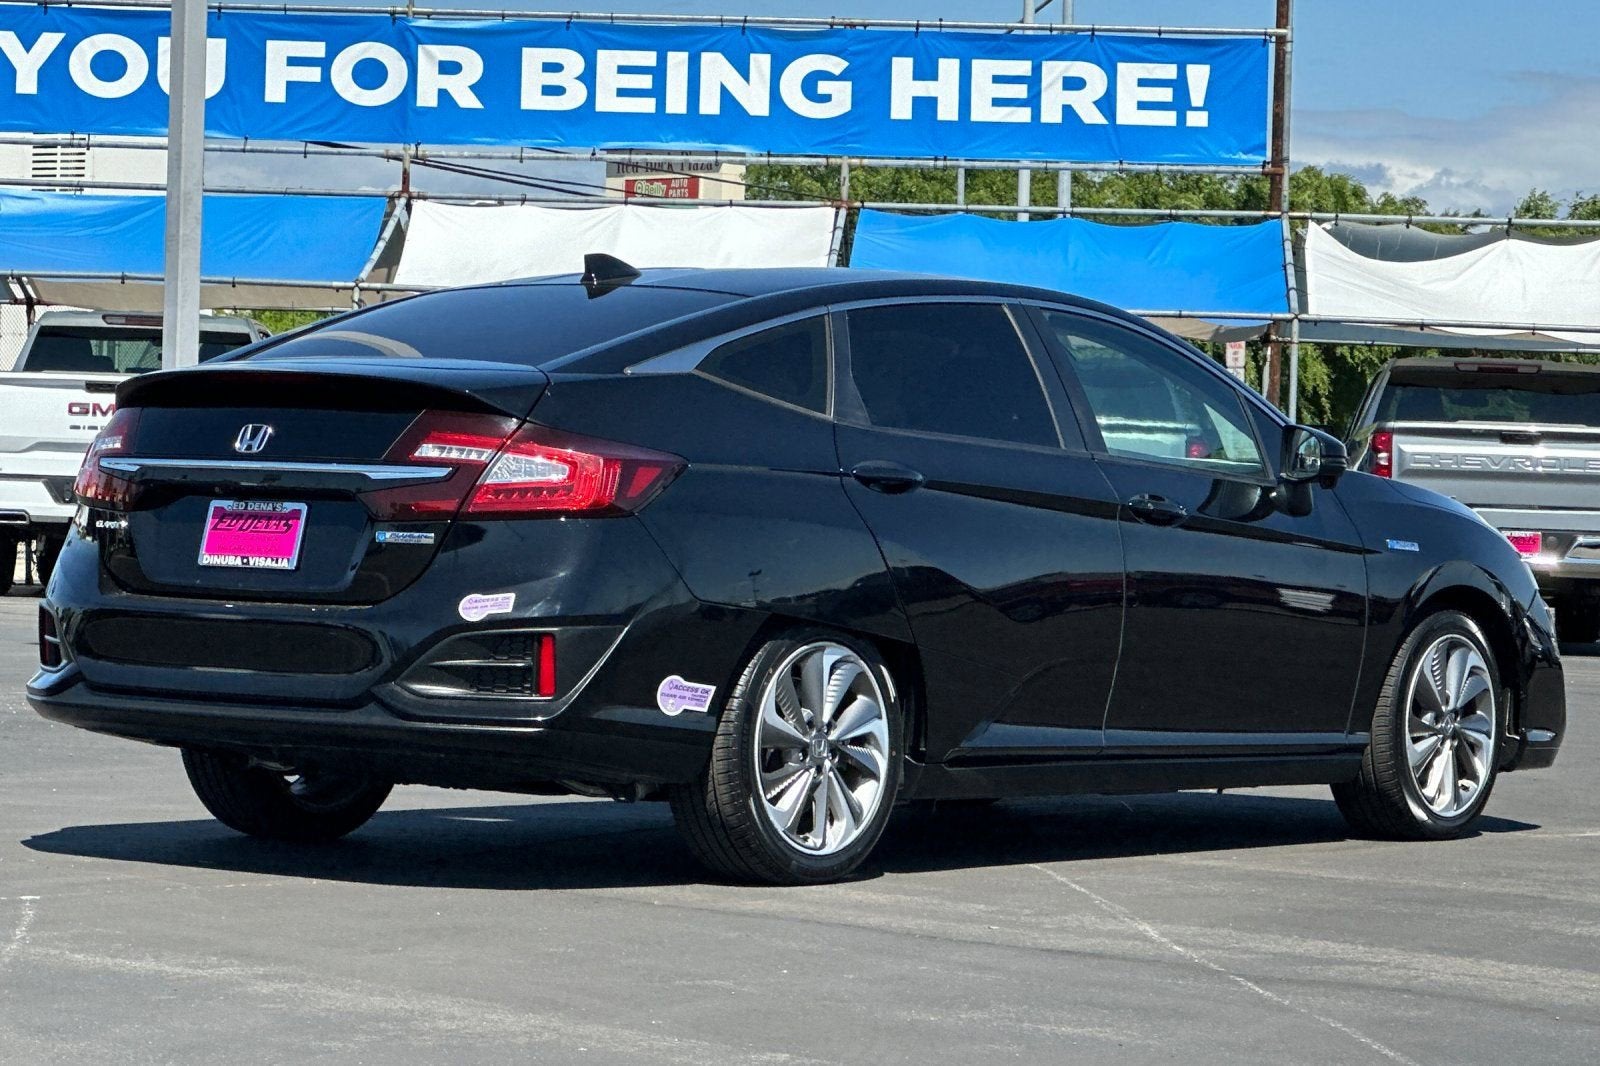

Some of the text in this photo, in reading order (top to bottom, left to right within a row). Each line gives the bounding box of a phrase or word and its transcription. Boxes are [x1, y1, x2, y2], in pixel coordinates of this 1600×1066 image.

[0, 31, 1211, 127] YOU FOR BEING HERE!
[680, 151, 713, 171] Plaza
[671, 179, 688, 187] AUTO
[669, 188, 689, 197] PARTS
[233, 501, 283, 511] ED DENA'S
[203, 554, 289, 567] DINUBA VISALIA
[673, 684, 699, 694] ACCESS
